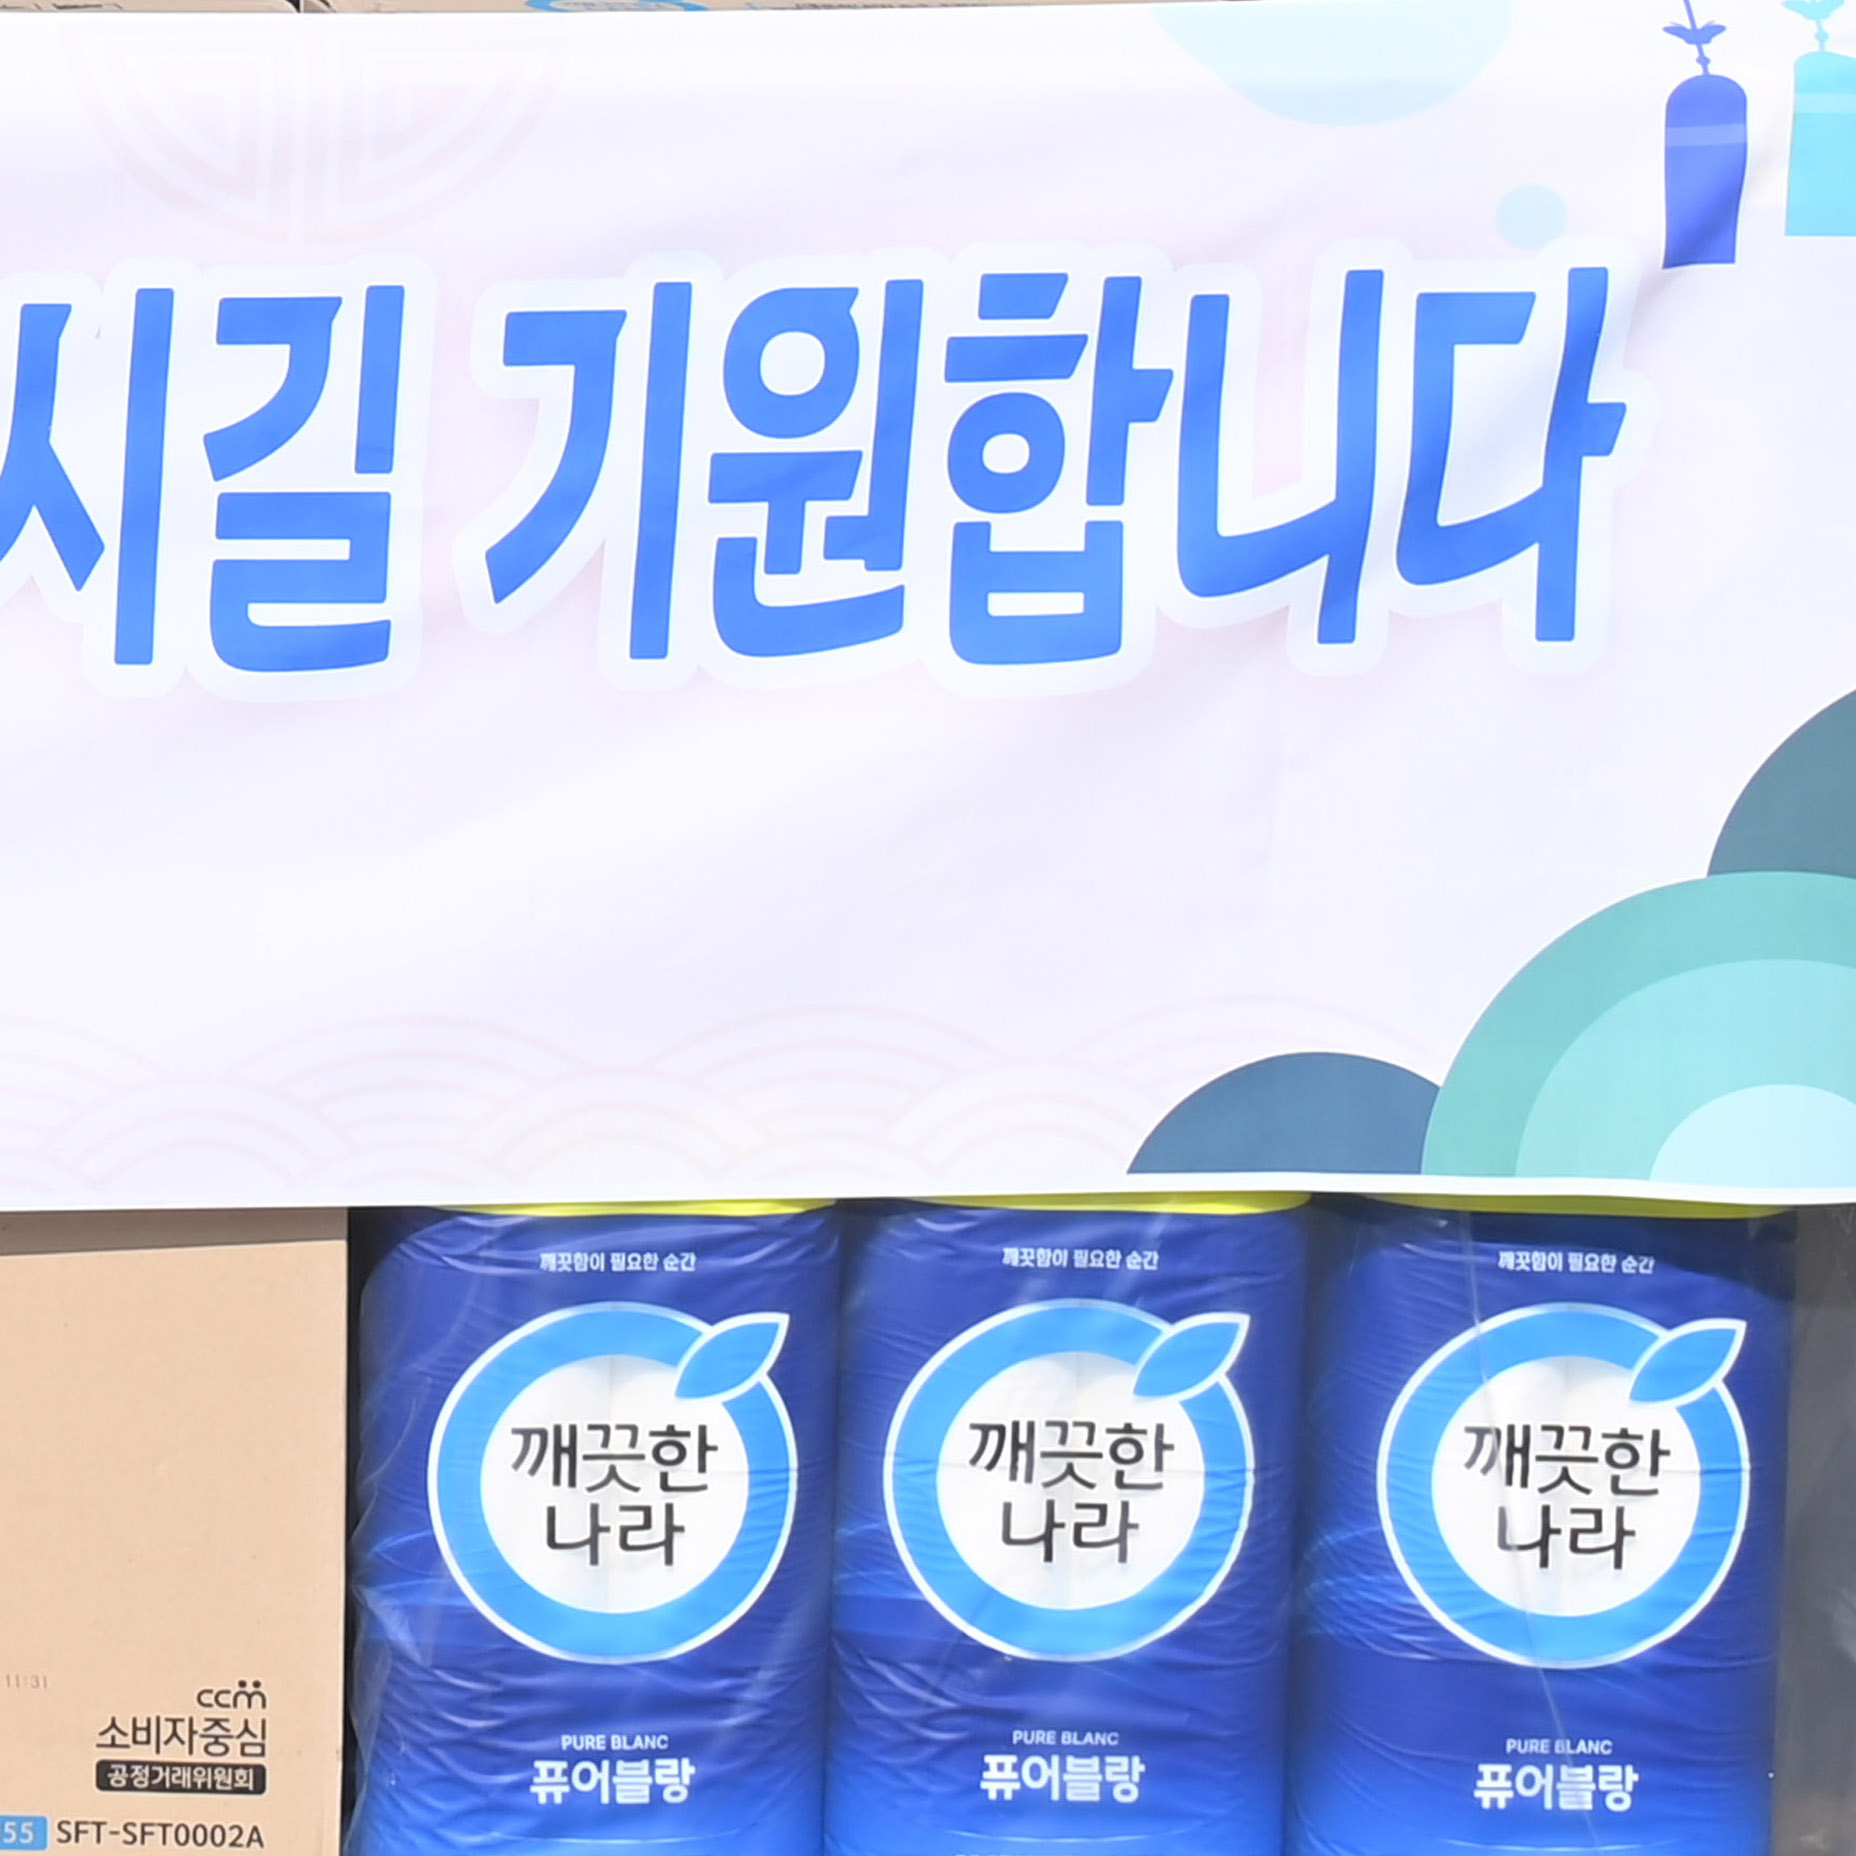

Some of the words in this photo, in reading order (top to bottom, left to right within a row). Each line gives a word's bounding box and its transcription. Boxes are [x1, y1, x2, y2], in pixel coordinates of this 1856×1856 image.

[485, 267, 1627, 665] 기원합니다
[663, 1252, 697, 1272] 순간
[1126, 1250, 1159, 1270] 순간
[1621, 1254, 1655, 1275] 순간
[510, 1422, 718, 1492] 깨끗한
[968, 1419, 1175, 1491] 깨끗한
[1463, 1423, 1670, 1496] 깨끗한
[545, 1503, 685, 1567] 나라
[1002, 1500, 1139, 1564] 나라
[1498, 1504, 1636, 1570] 나라
[96, 1715, 267, 1758] 소비자중심
[561, 1734, 606, 1751] PURE
[610, 1734, 669, 1750] BLANC
[1012, 1730, 1056, 1745] PURE
[1061, 1731, 1119, 1746] BLANC
[1506, 1738, 1550, 1754] PURE
[1554, 1738, 1613, 1755] BLANC
[107, 1763, 254, 1791] 공정거래위원회
[529, 1758, 696, 1805] 퓨어블랑
[980, 1754, 1146, 1804] 퓨어블랑
[1474, 1763, 1639, 1812] 퓨어블랑
[56, 1819, 265, 1849] SFT-SFT0002A
